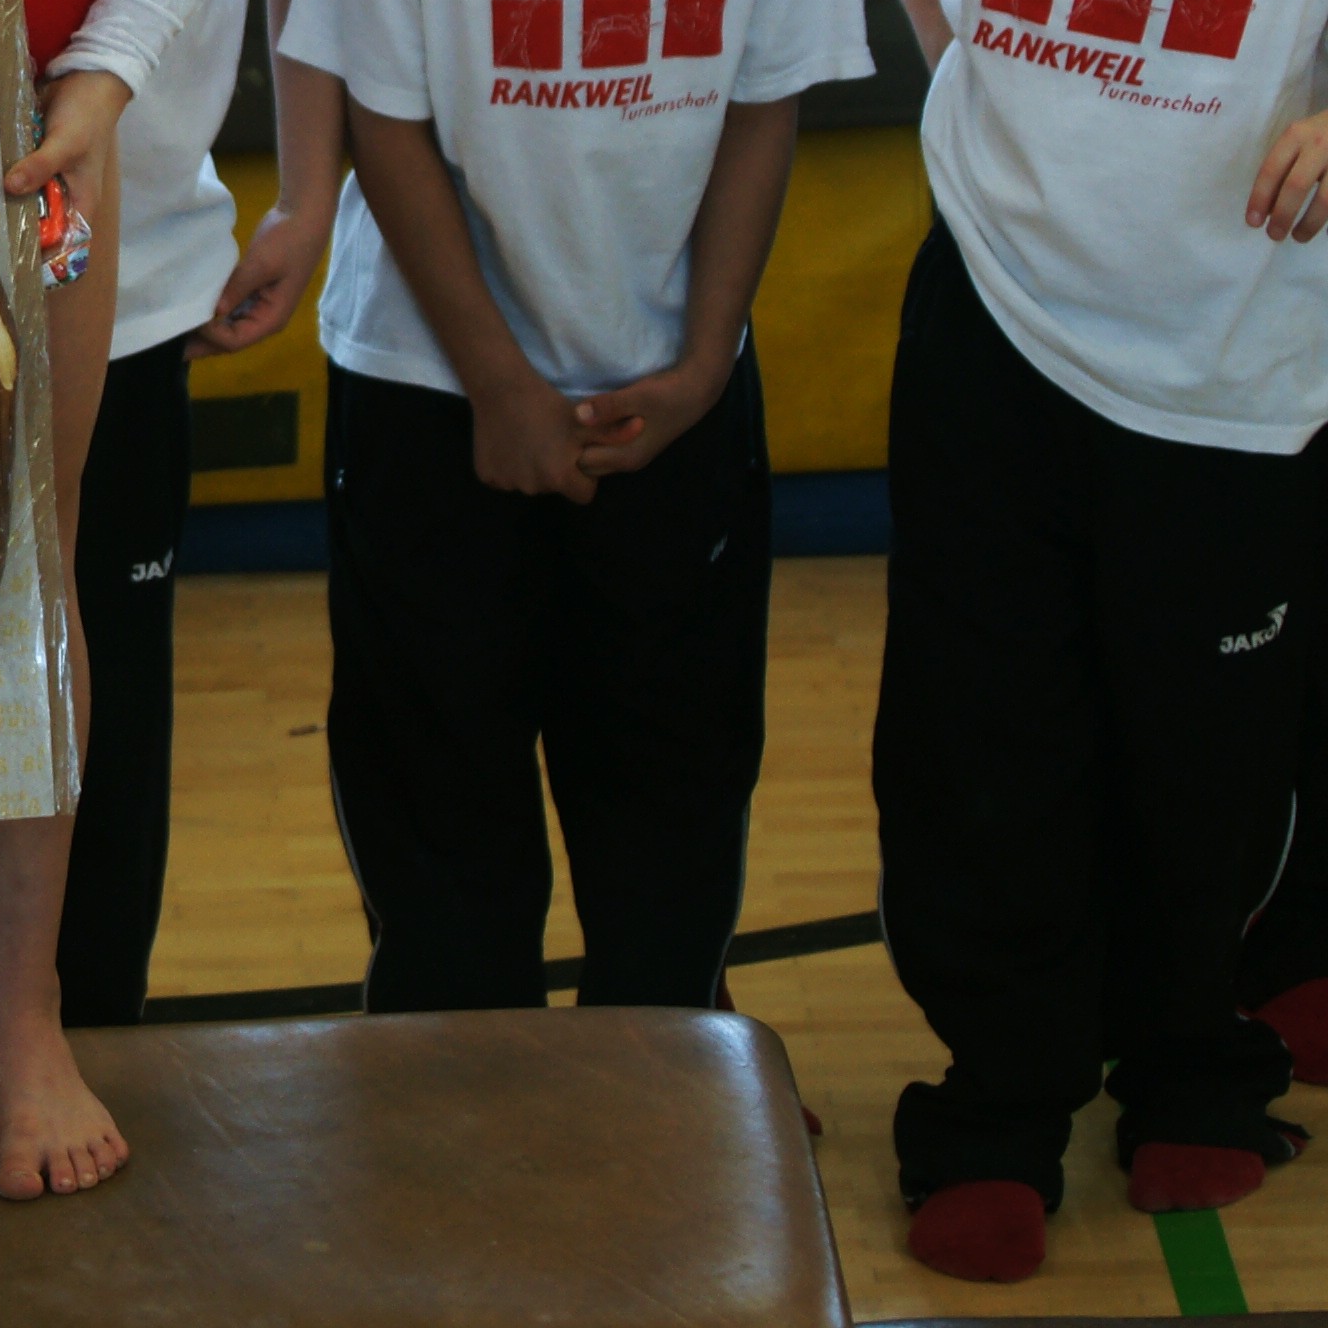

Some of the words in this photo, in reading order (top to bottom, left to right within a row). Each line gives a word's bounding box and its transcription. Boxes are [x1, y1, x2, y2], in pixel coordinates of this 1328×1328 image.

[972, 19, 1145, 87] RANKWEIL
[490, 74, 654, 108] RANKWEIL
[620, 88, 719, 122] Turnerschaft
[1098, 80, 1223, 115] Turnerschaft
